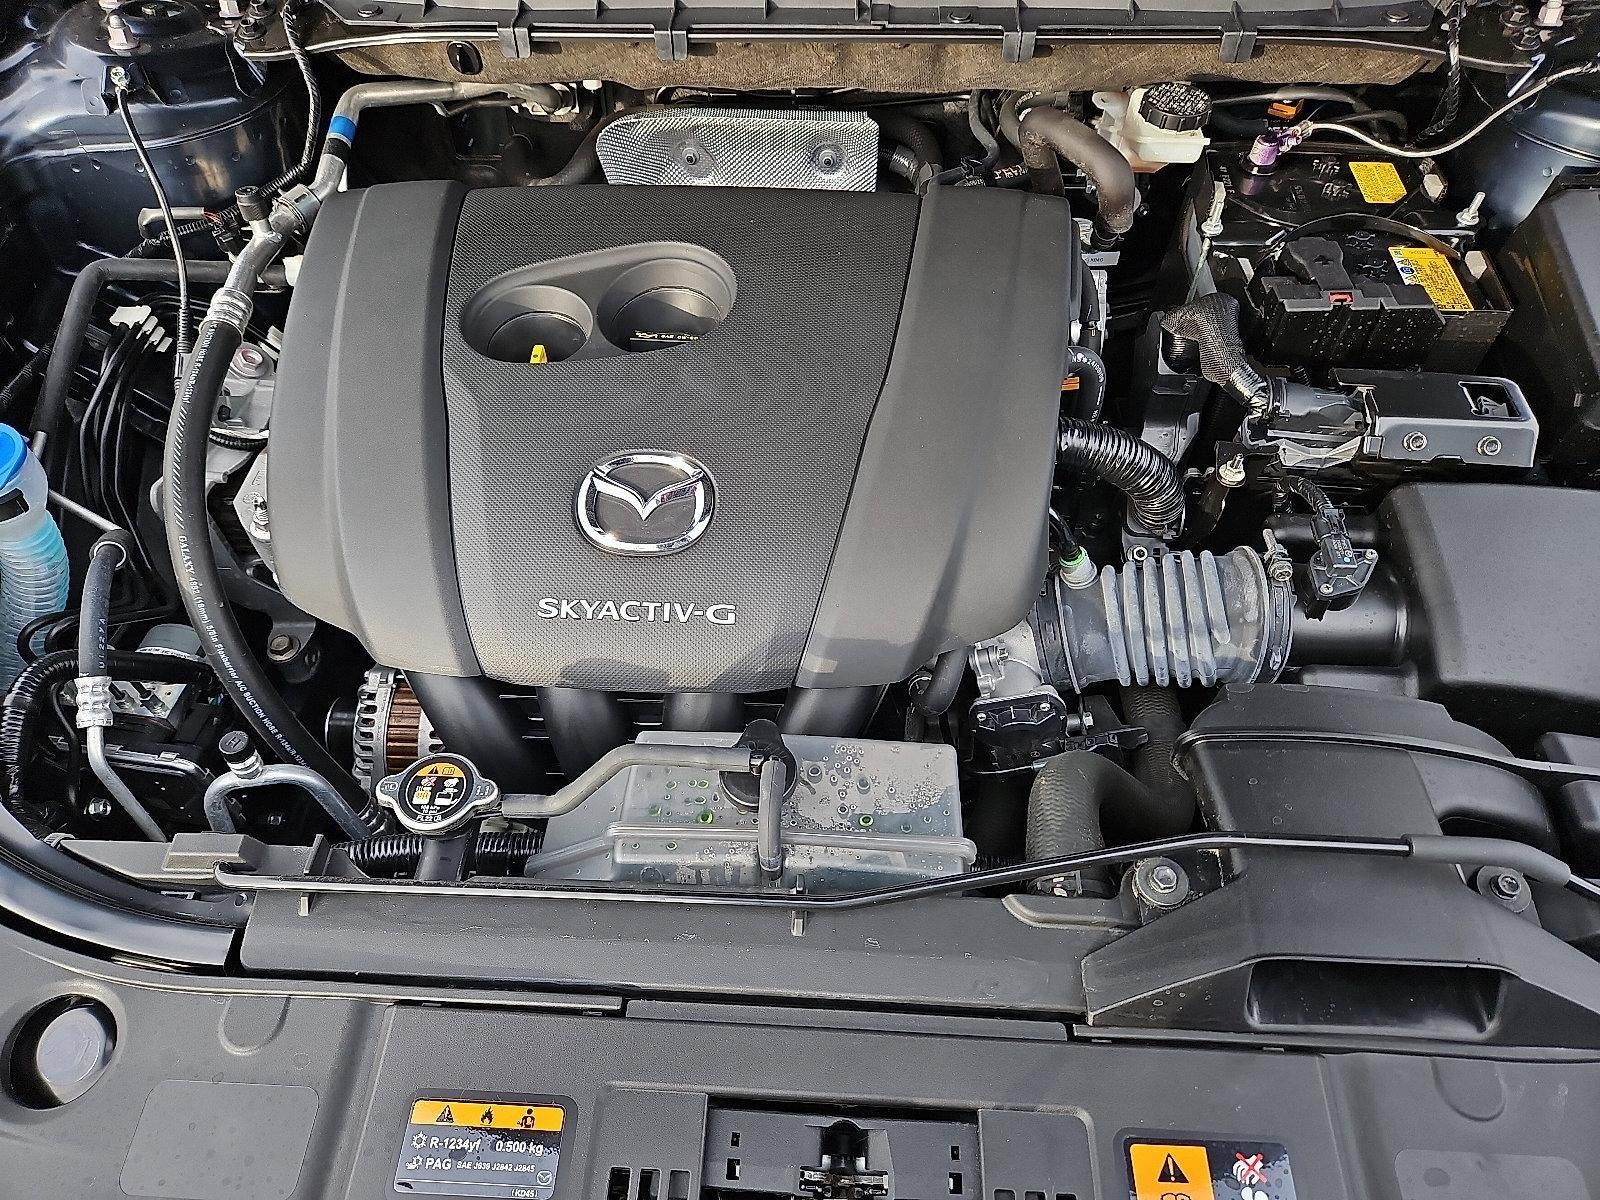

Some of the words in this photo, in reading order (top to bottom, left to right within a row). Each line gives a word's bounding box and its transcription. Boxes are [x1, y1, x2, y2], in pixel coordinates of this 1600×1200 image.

[537, 598, 737, 625] SKYACTIV-G
[178, 535, 195, 574] GALAXY
[243, 692, 267, 719] SUCTION
[261, 718, 279, 735] HOSE
[429, 1136, 481, 1152] R-1234yf
[496, 1140, 527, 1153] 0.500
[528, 1142, 544, 1157] kg
[425, 1157, 452, 1170] PAG
[457, 1161, 473, 1170] SAE
[474, 1161, 491, 1170] J639
[492, 1163, 513, 1172] J2842
[514, 1163, 536, 1172] J2845
